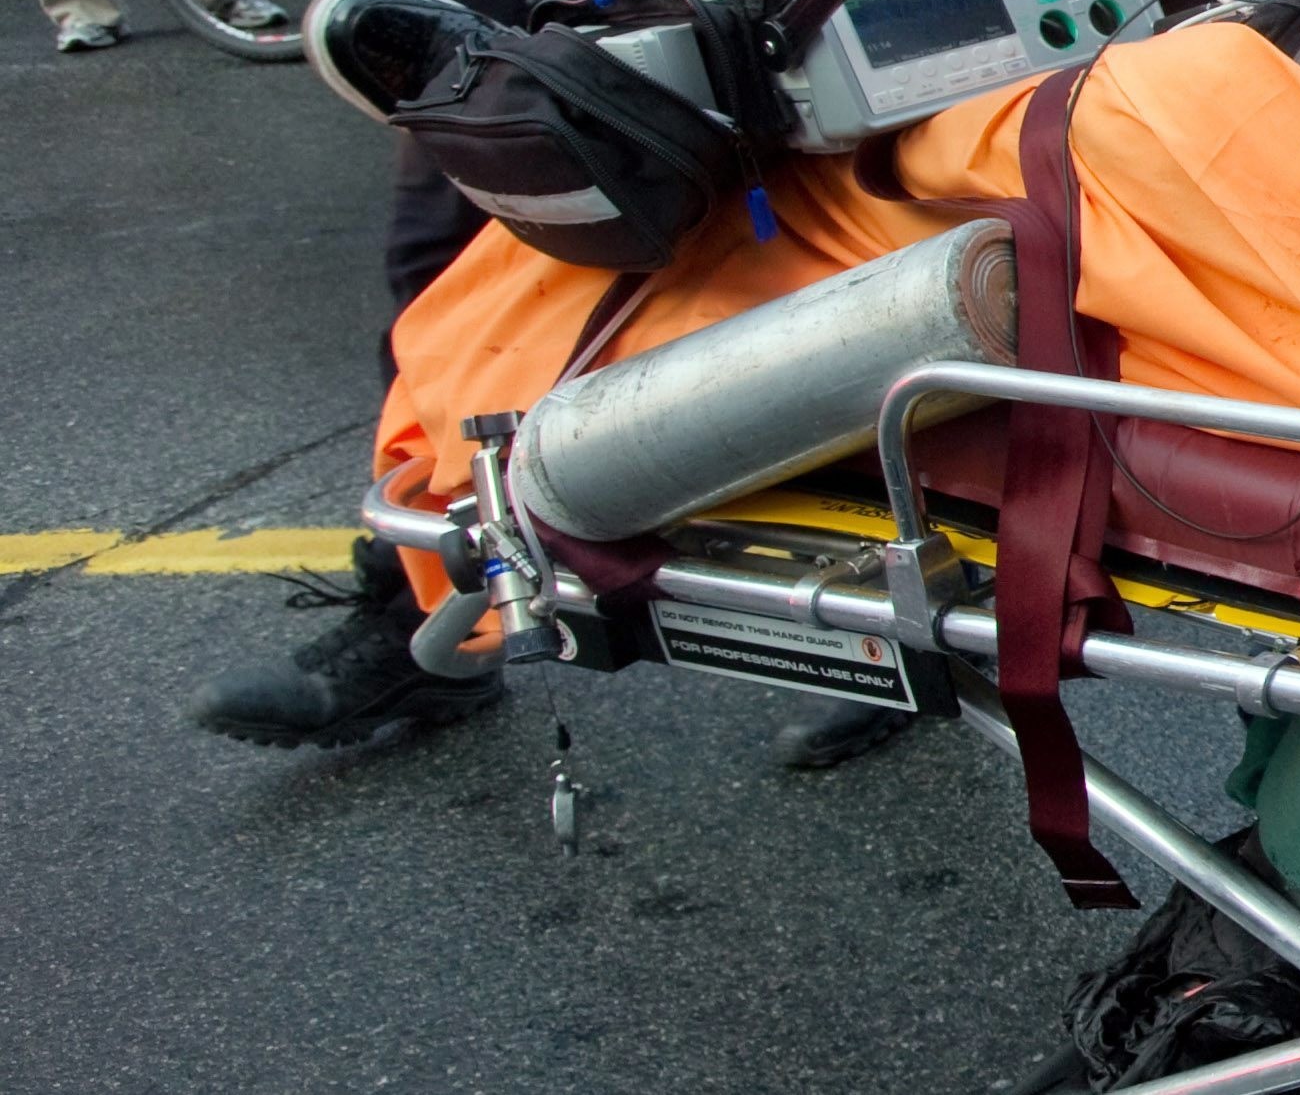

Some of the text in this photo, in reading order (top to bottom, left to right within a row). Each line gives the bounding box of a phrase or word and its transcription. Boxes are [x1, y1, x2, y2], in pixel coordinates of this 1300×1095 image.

[661, 610, 843, 649] DO NOT REMOVE THIS HAND GUARD
[671, 639, 896, 689] FOR PROFESSIONAL USE ONLY
